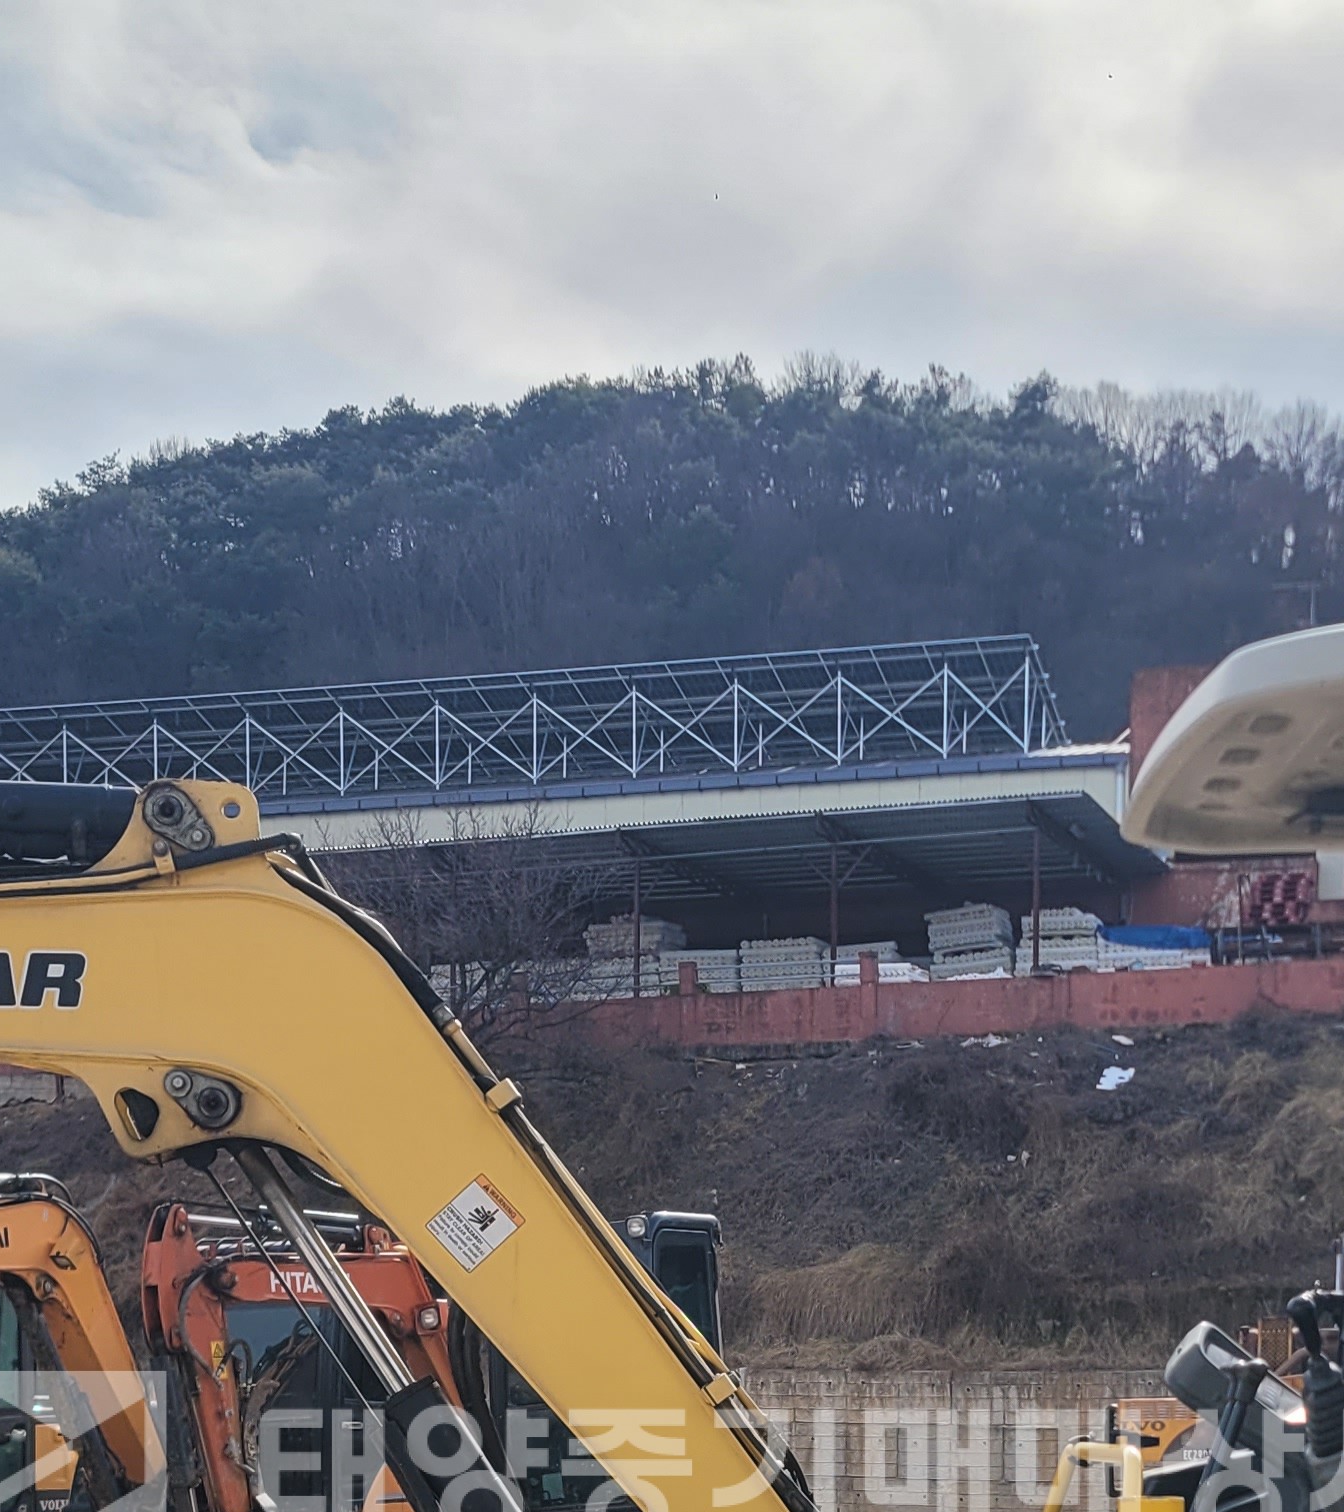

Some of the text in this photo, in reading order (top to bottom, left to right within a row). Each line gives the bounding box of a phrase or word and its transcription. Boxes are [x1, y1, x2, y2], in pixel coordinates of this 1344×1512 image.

[487, 1188, 517, 1218] WARNING
[269, 1271, 350, 1293] HITA
[39, 1499, 70, 1511] VOLV
